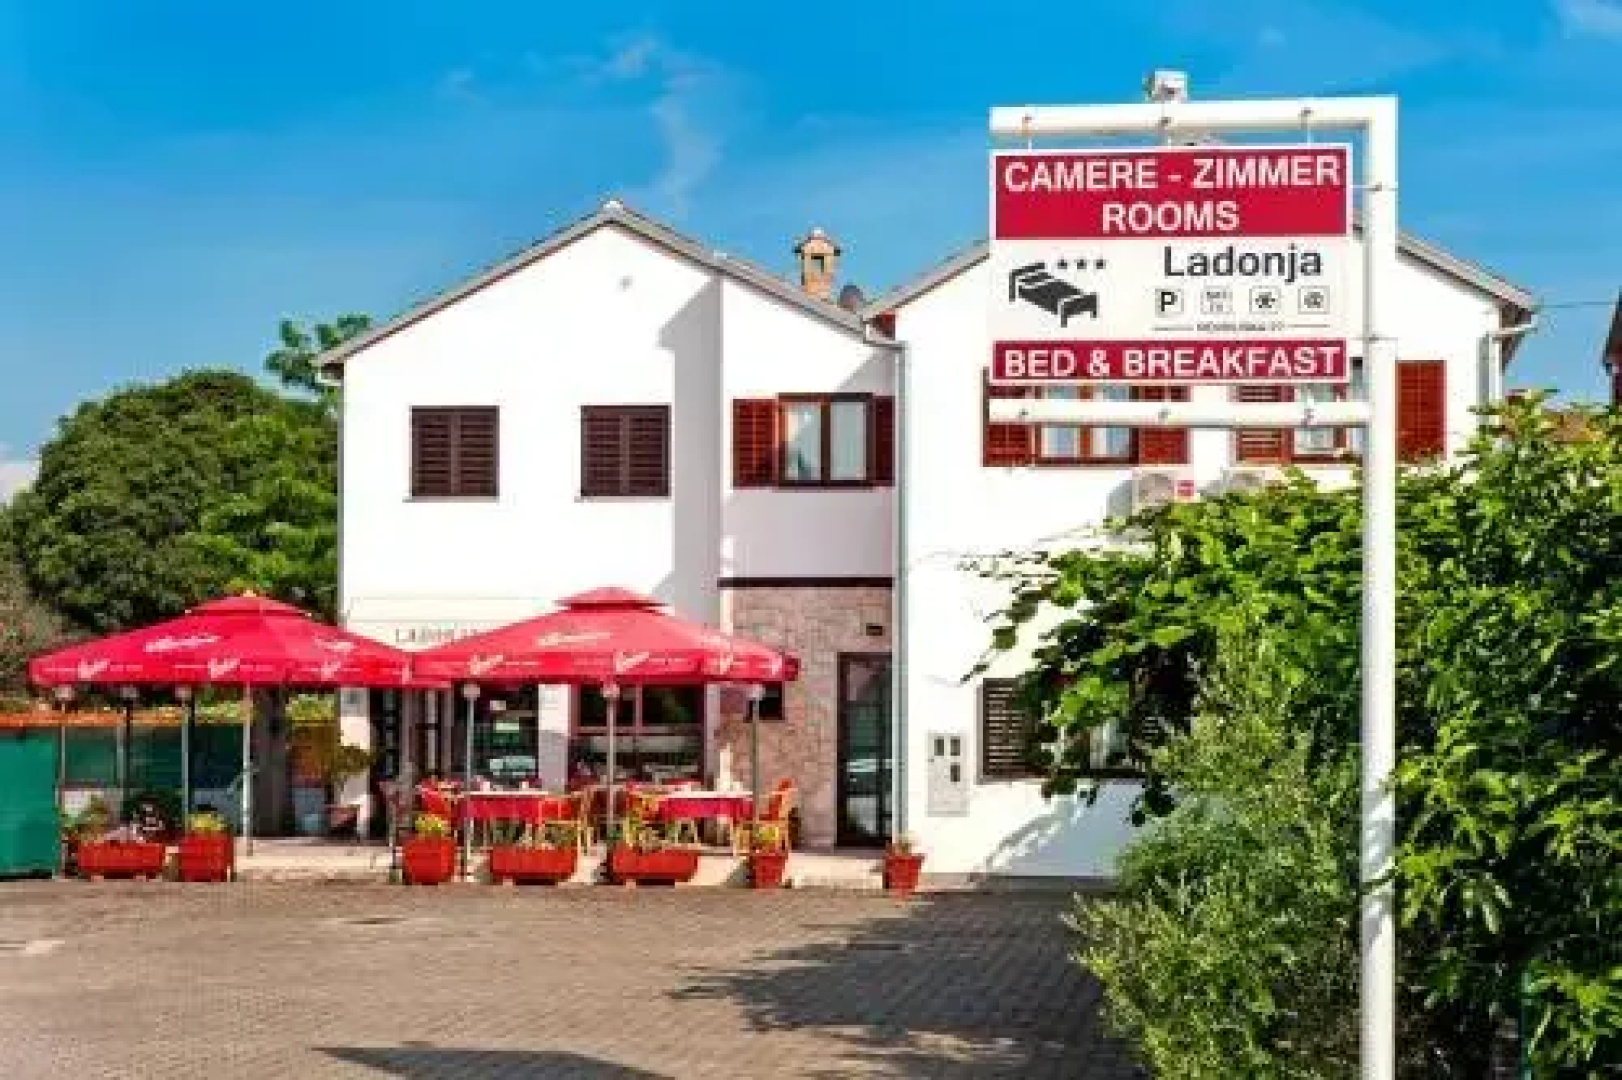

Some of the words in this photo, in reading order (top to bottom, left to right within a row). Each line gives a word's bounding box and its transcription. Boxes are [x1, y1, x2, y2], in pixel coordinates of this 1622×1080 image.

[1005, 159, 1158, 192] CAMERE
[1192, 155, 1341, 188] ZIMMER
[1102, 201, 1239, 233] ROOMS
[1164, 243, 1323, 284] Ladonja
[1160, 291, 1177, 312] P
[1004, 349, 1075, 377] BED
[1087, 350, 1110, 374] &
[1122, 346, 1341, 376] BREAKFAST
